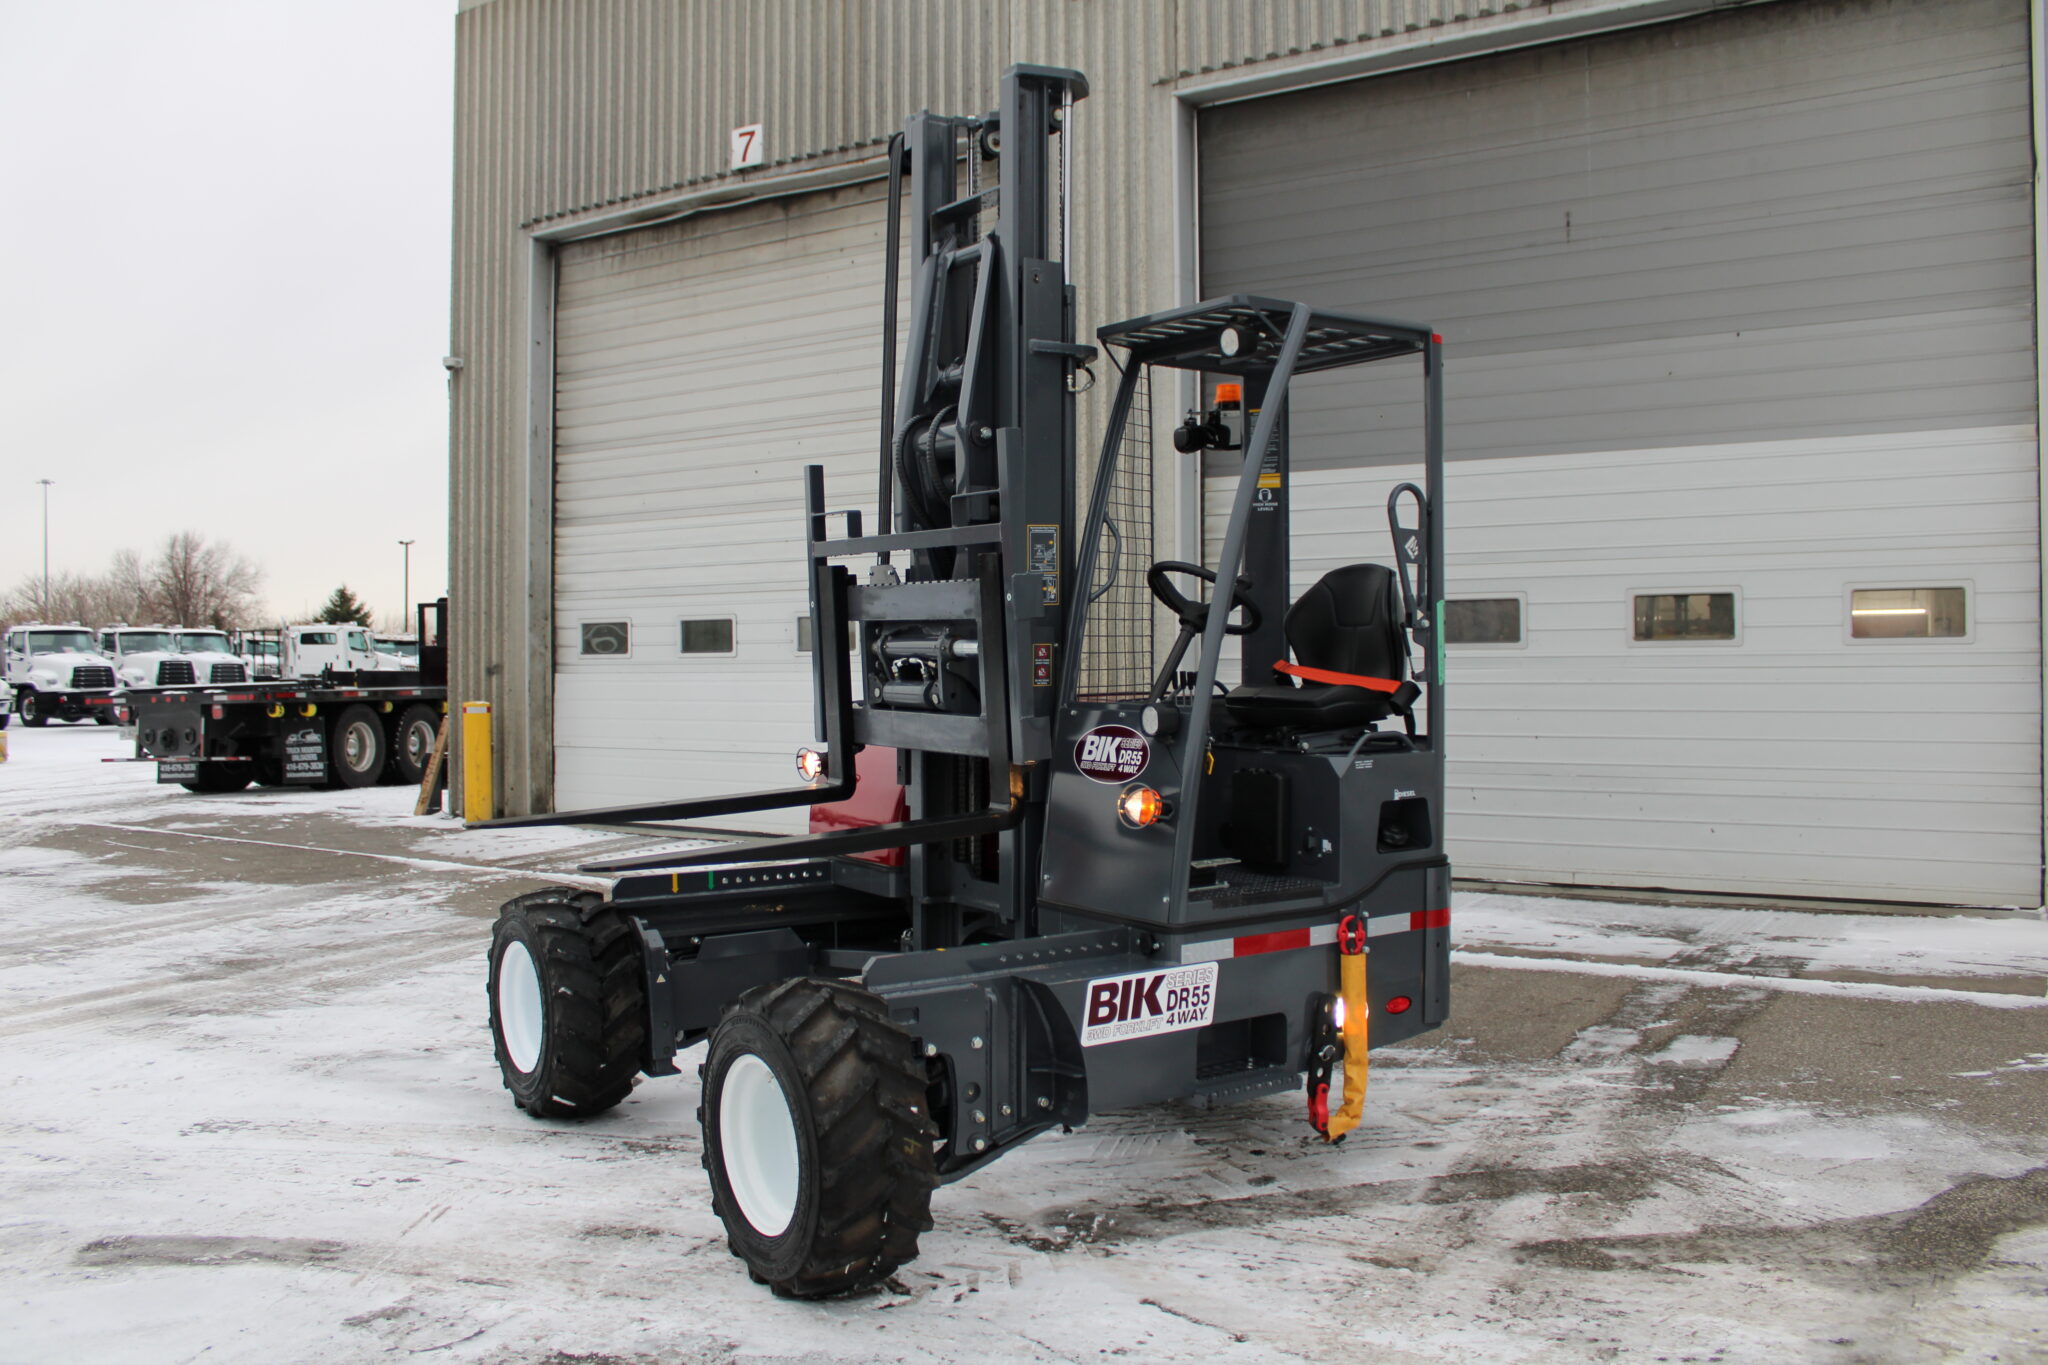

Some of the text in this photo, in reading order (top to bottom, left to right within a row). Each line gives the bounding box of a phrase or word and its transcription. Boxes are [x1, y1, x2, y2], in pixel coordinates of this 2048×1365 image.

[738, 130, 756, 163] 7
[1081, 735, 1123, 764] BIK
[1118, 749, 1144, 766] DR55
[1118, 764, 1123, 773] 4
[1166, 967, 1214, 989] SERIES
[1087, 974, 1167, 1028] BIK
[1166, 984, 1211, 1012] DR55
[1166, 1007, 1208, 1026] 4 WAY
[1086, 1017, 1164, 1042] 3WD FORKLIFT
